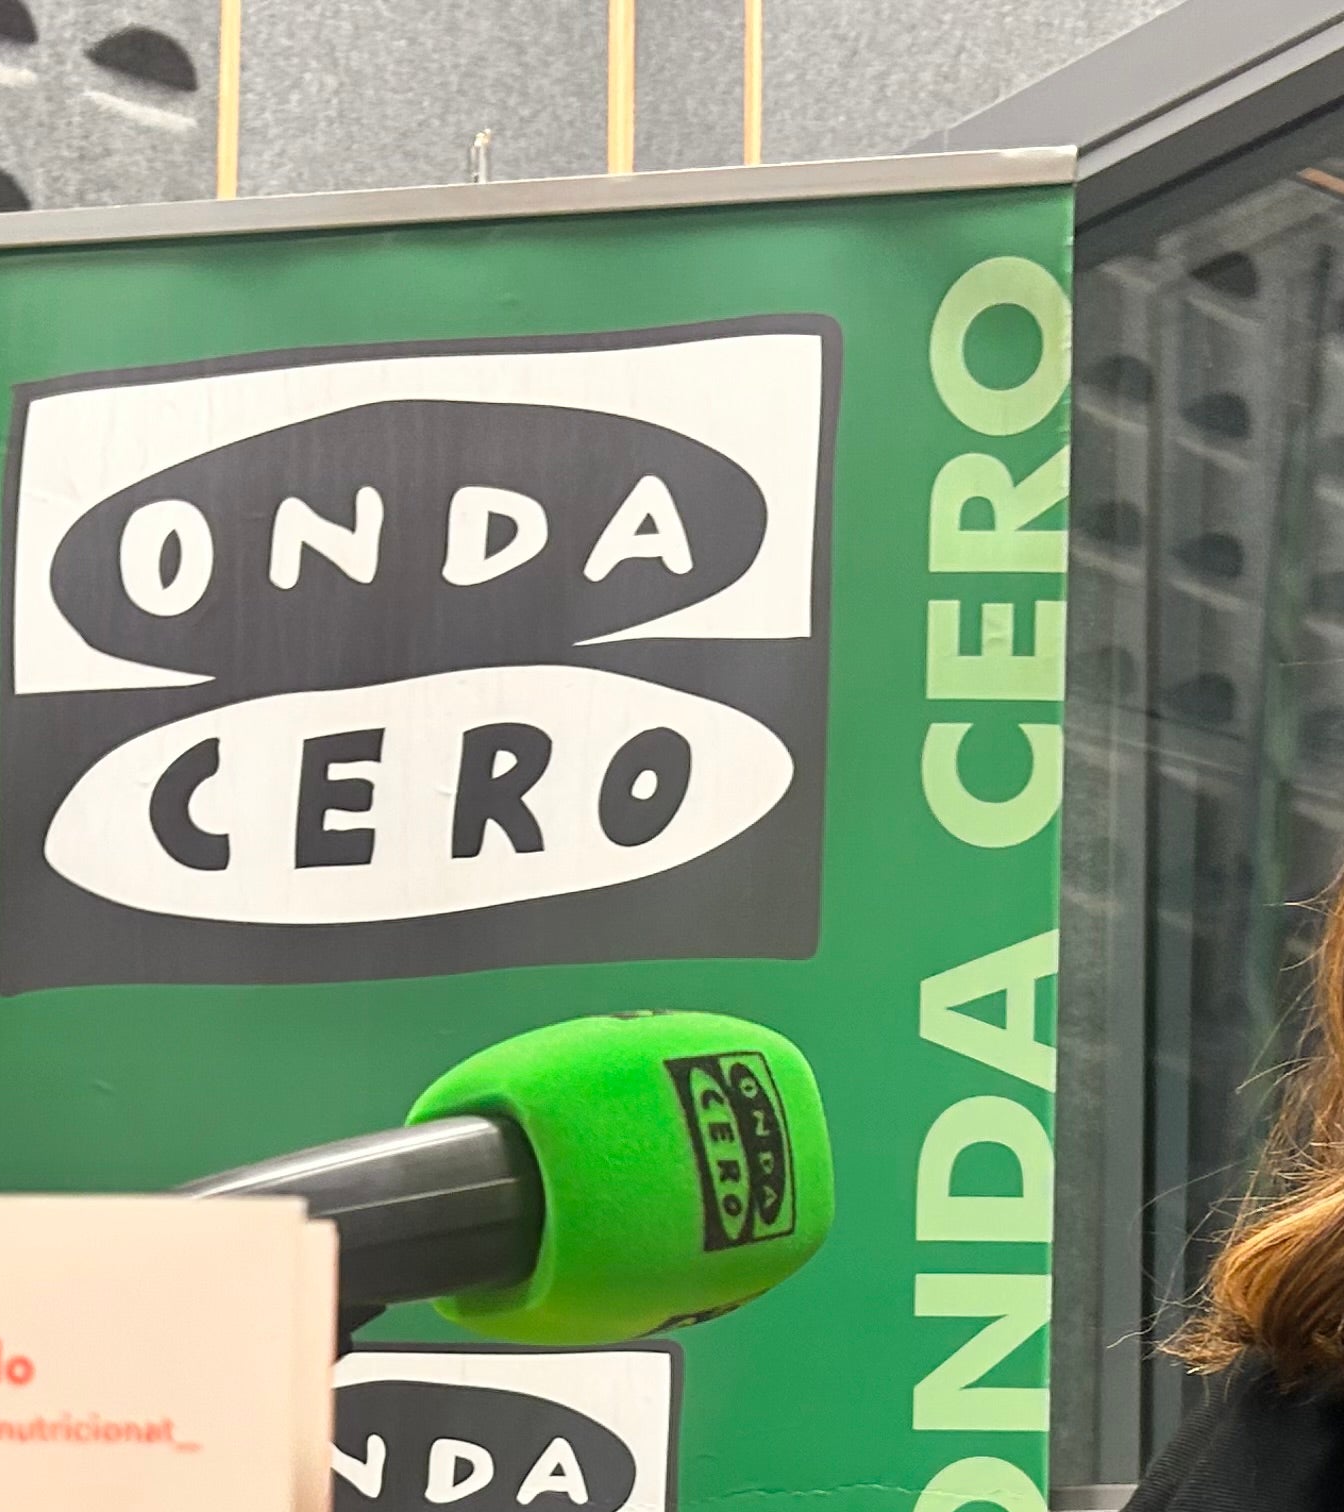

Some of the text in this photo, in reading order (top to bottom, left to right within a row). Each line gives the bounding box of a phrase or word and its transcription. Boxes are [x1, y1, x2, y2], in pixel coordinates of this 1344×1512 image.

[119, 474, 694, 617] ONDA
[921, 253, 1074, 848] CERO
[149, 721, 692, 871] CERO
[701, 1089, 743, 1216] CERO
[739, 1076, 778, 1208] ONDA
[330, 1434, 588, 1505] NDA
